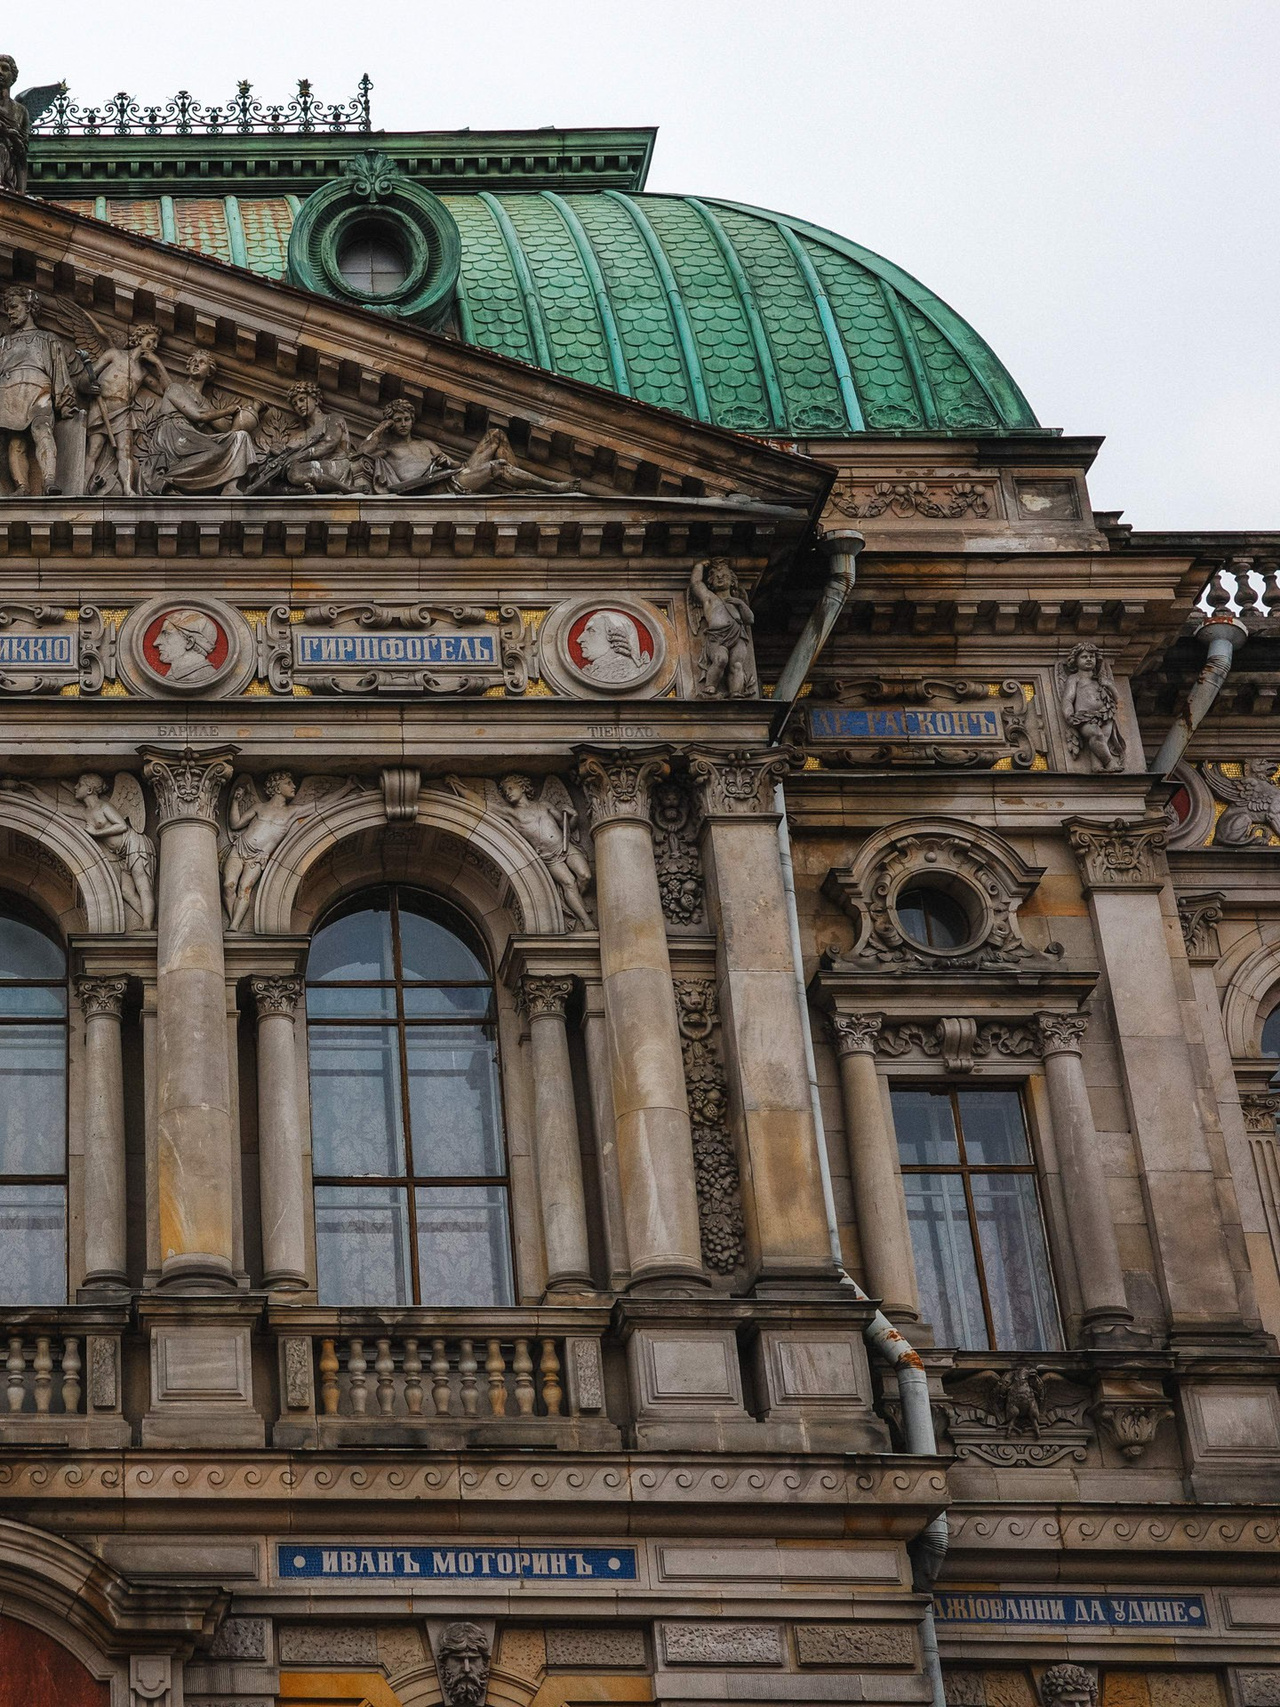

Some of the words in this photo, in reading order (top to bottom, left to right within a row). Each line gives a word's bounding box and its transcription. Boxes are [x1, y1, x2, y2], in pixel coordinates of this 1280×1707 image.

[302, 637, 490, 661] ГИРШФОГЕЛЬ
[157, 725, 219, 737] БАРИЛЕ
[321, 1551, 420, 1574] ИВАНЪ
[432, 1551, 593, 1575] МОТОРИНЪ
[1074, 1600, 1107, 1622] ДА
[1110, 1601, 1189, 1623] УДИНЕ
